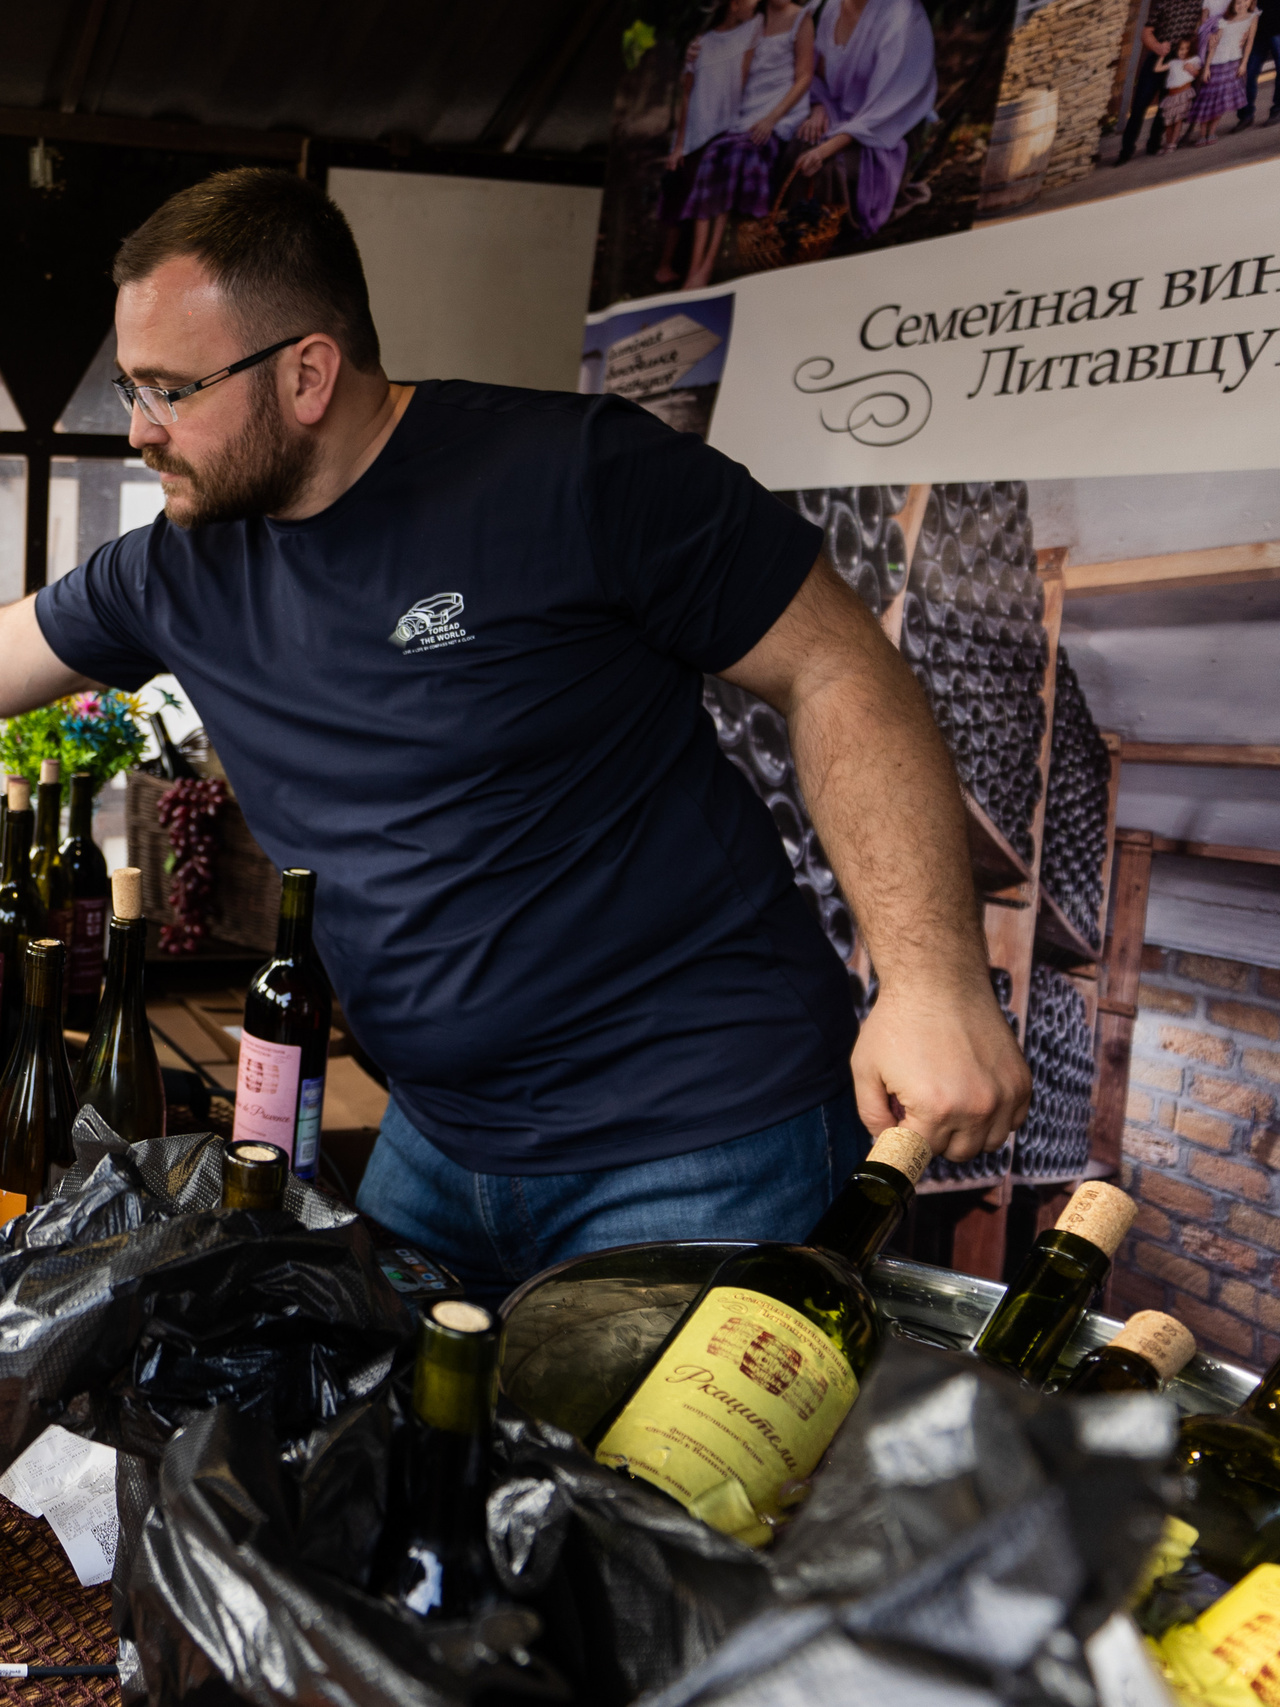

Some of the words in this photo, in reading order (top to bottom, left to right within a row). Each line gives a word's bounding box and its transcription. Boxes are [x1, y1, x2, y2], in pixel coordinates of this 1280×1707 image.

[859, 277, 1144, 352] Семейная
[967, 327, 1280, 399] Литавщу
[420, 636, 436, 645] THE
[436, 629, 466, 642] WORLD
[429, 623, 460, 635] TOREAD
[665, 1364, 799, 1473] Ркацители
